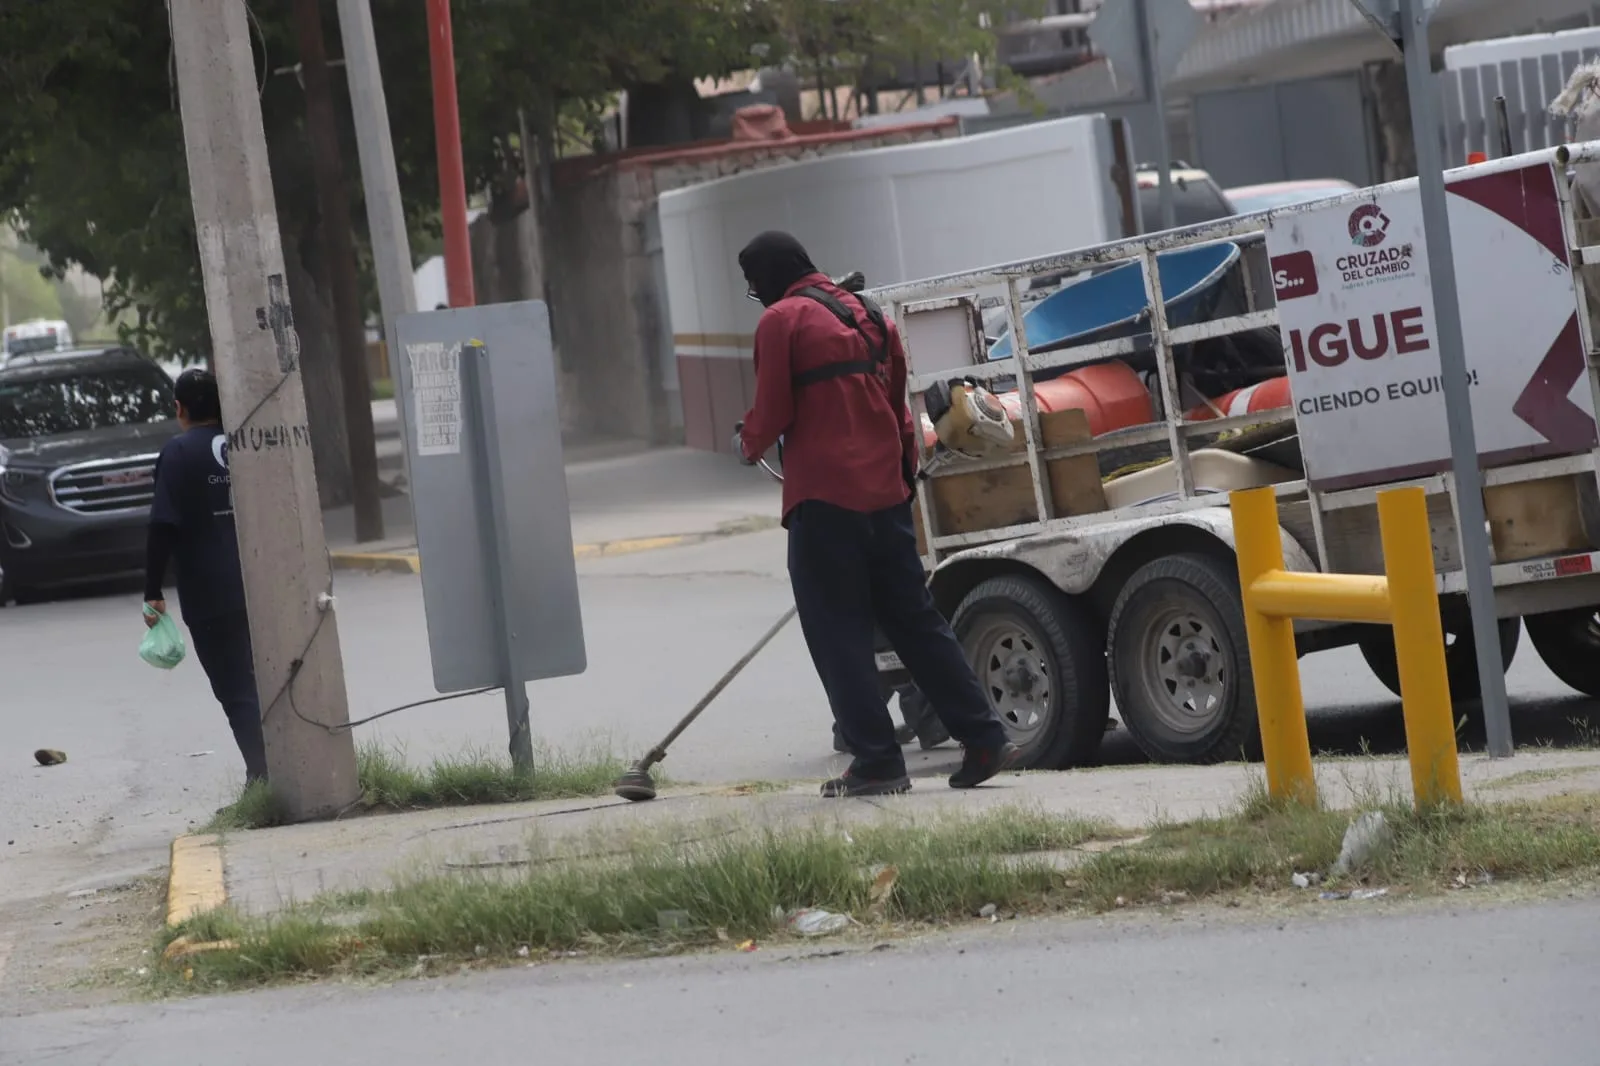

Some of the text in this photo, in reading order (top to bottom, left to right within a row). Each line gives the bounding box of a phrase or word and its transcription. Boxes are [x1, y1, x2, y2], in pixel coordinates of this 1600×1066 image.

[1343, 260, 1410, 282] DEL CAMBIO
[1297, 386, 1381, 416] CIENDO
